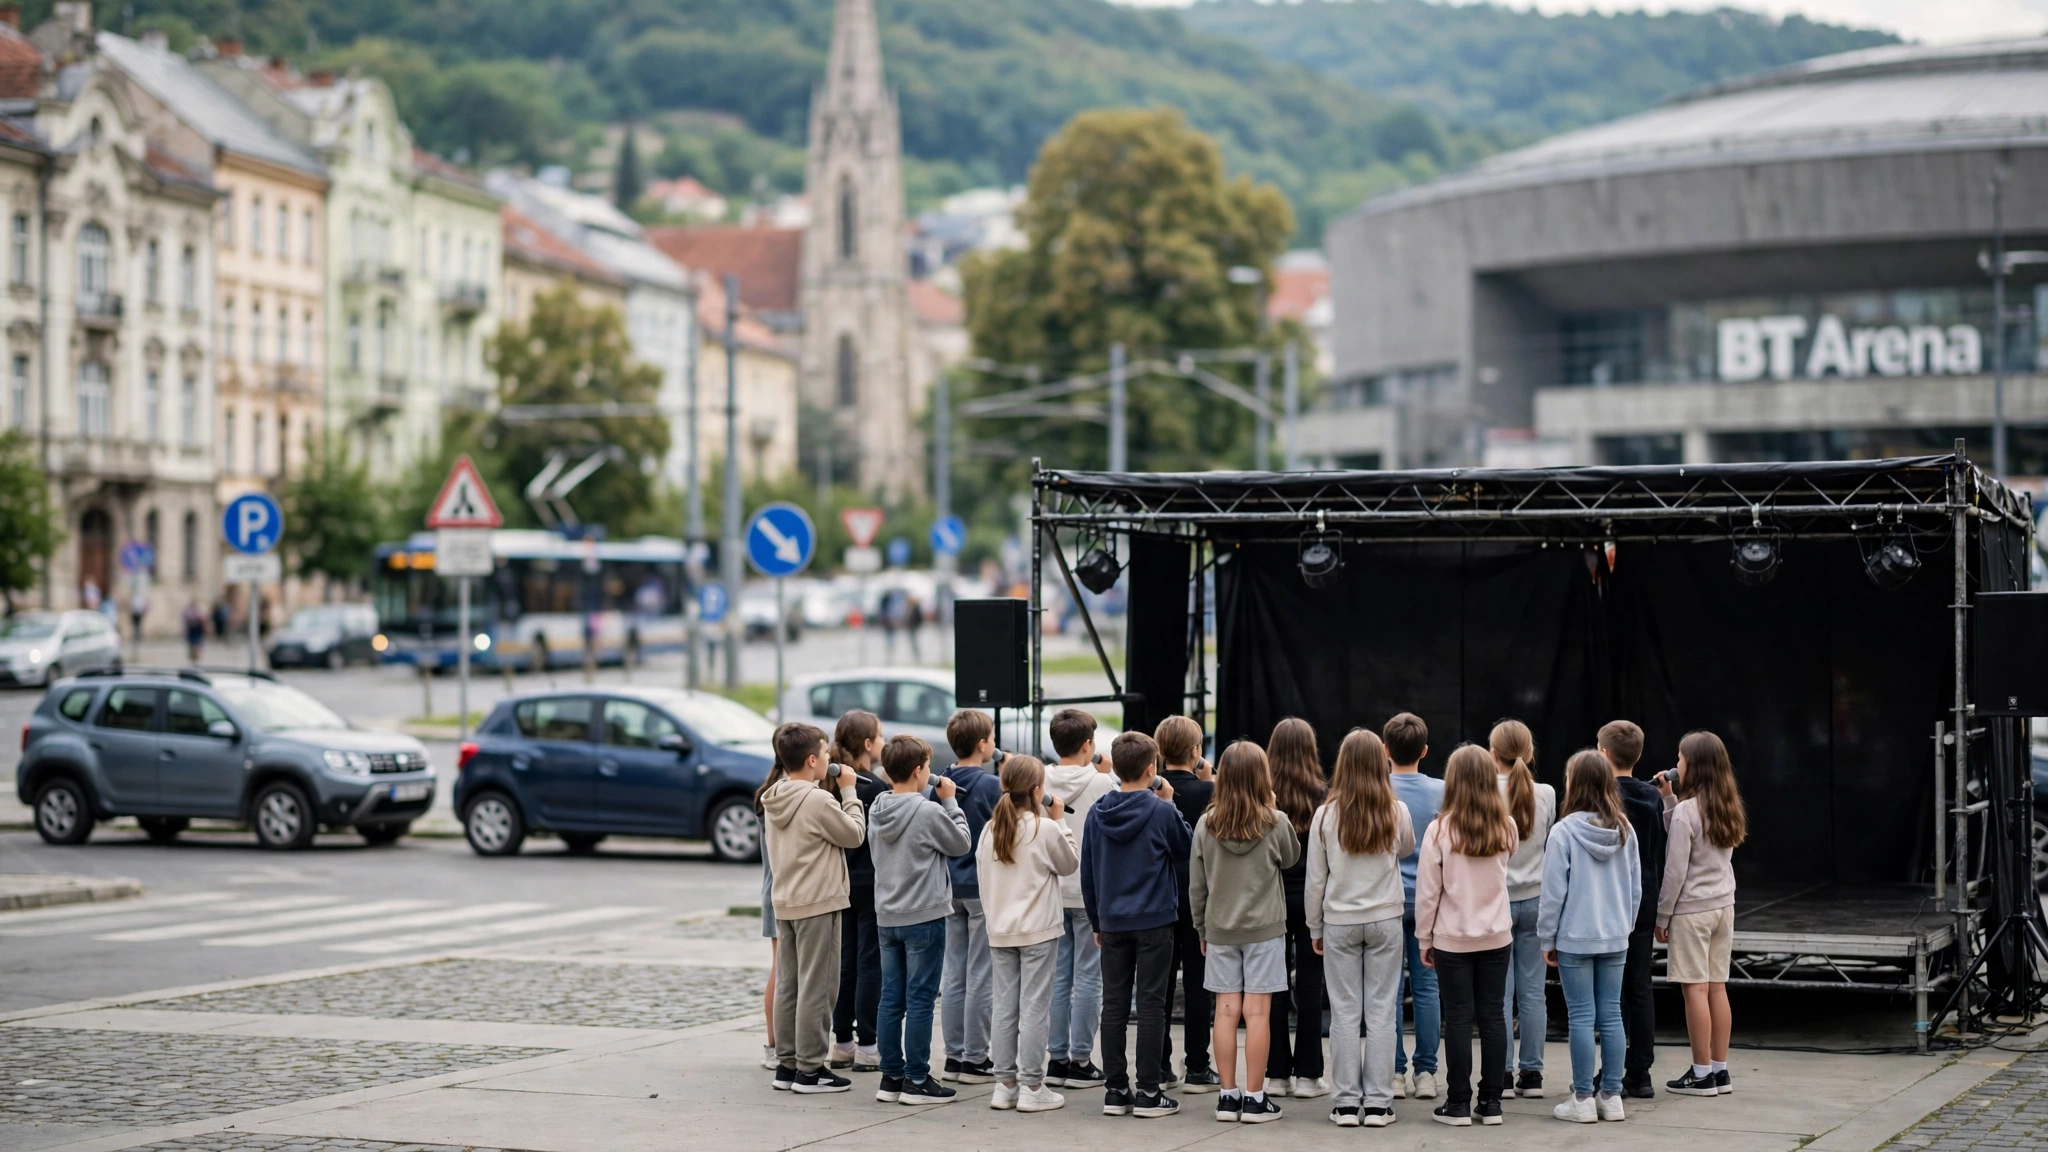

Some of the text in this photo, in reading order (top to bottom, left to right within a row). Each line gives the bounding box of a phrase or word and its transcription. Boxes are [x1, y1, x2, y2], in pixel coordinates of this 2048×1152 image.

[1717, 314, 1982, 382] BT Arena
[239, 500, 268, 547] P
